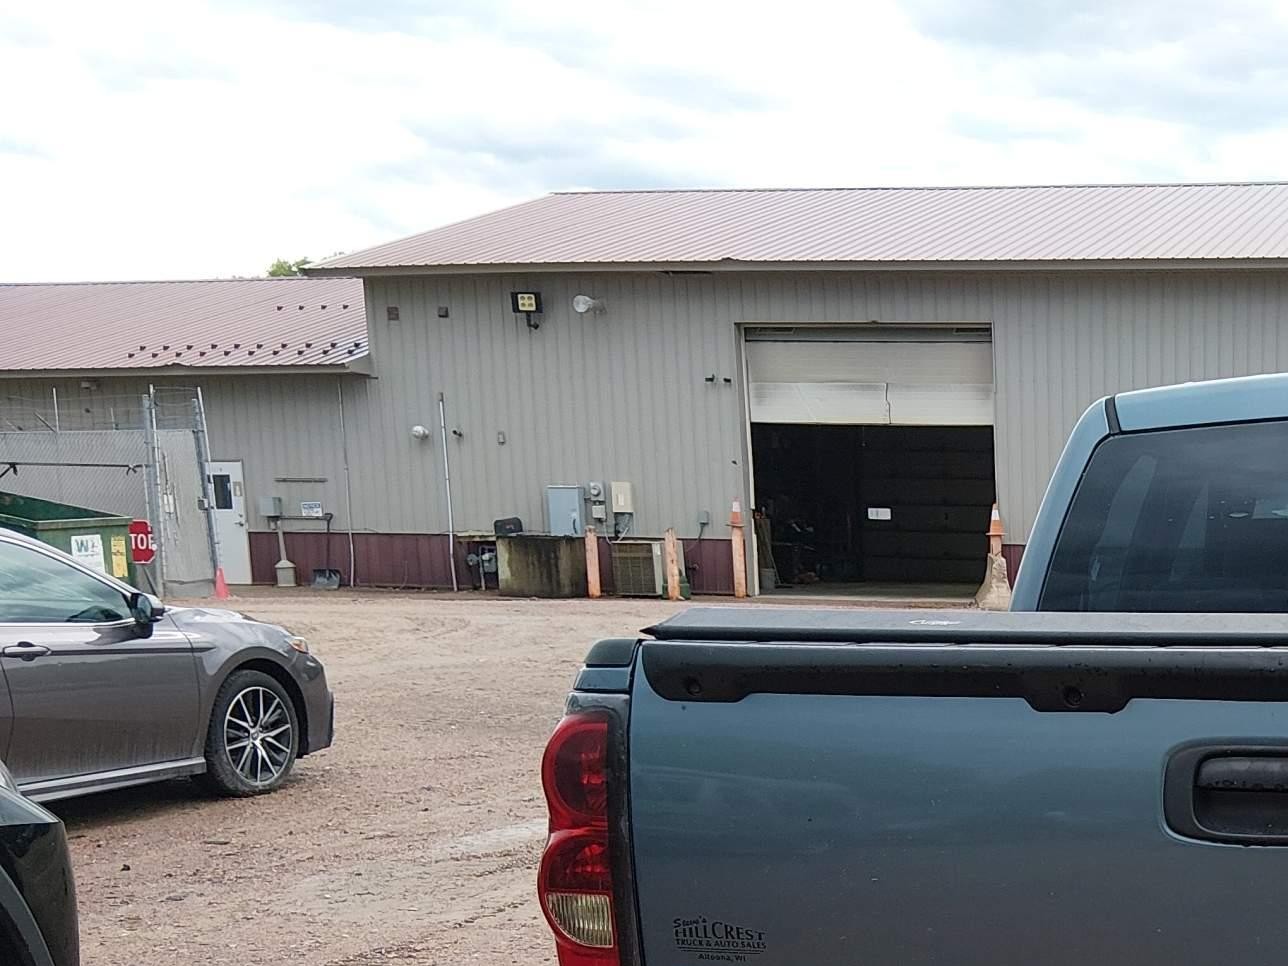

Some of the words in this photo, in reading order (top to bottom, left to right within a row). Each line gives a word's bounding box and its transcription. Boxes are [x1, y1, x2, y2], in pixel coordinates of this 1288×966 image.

[128, 533, 154, 550] TOP
[675, 938, 704, 947] TRUCK
[714, 940, 738, 948] AUTO
[739, 941, 767, 950] SALES
[735, 954, 746, 962] WI
